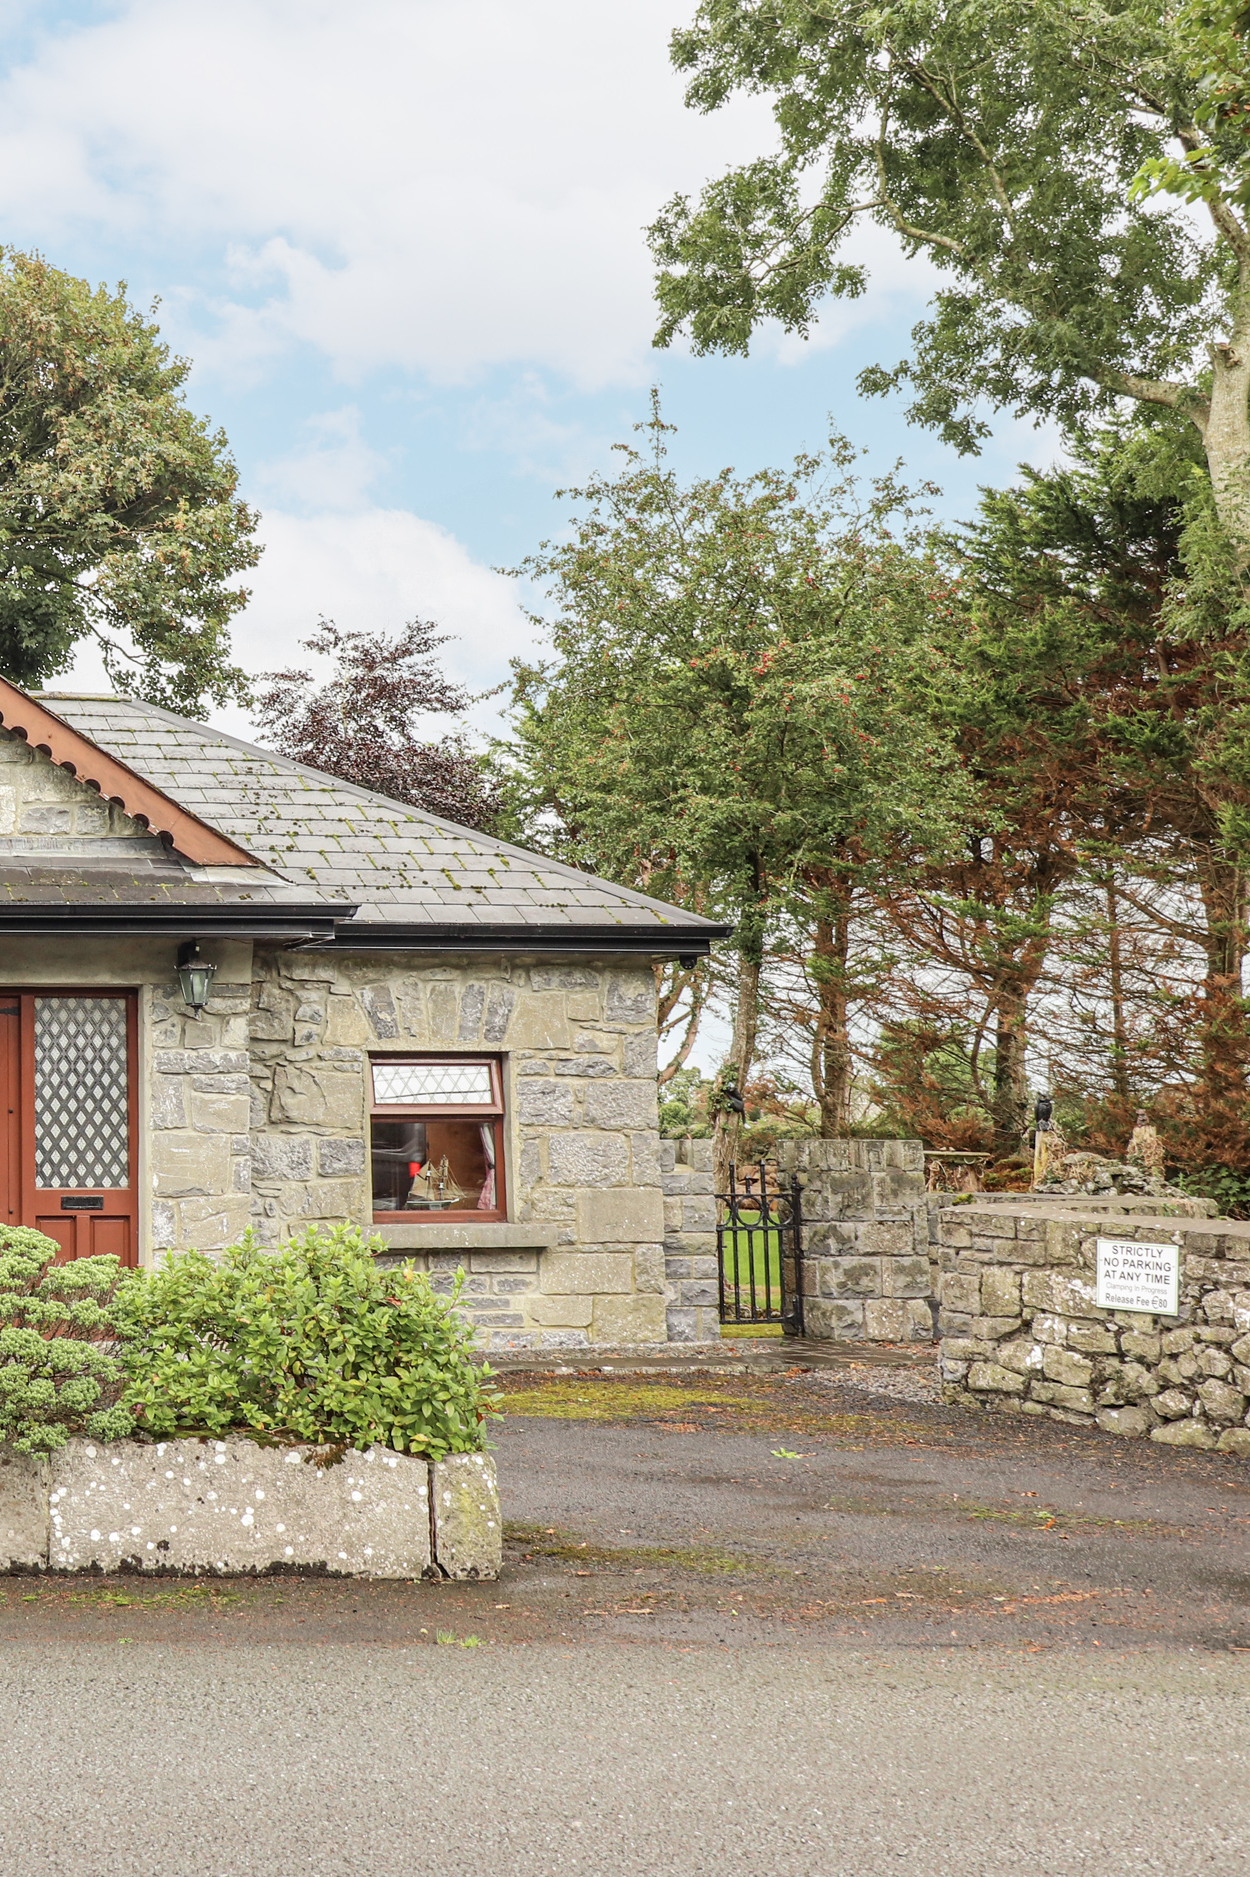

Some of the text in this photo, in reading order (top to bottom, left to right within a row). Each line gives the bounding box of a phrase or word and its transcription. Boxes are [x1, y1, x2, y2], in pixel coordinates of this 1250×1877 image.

[1111, 1245, 1164, 1258] STRICTLY
[1103, 1257, 1171, 1272] NO PARKING
[1103, 1270, 1170, 1285] AT ANY TIME
[1105, 1282, 1133, 1292] Clamping
[1141, 1285, 1168, 1295] Progress
[1105, 1293, 1168, 1309] Release Fee €80
